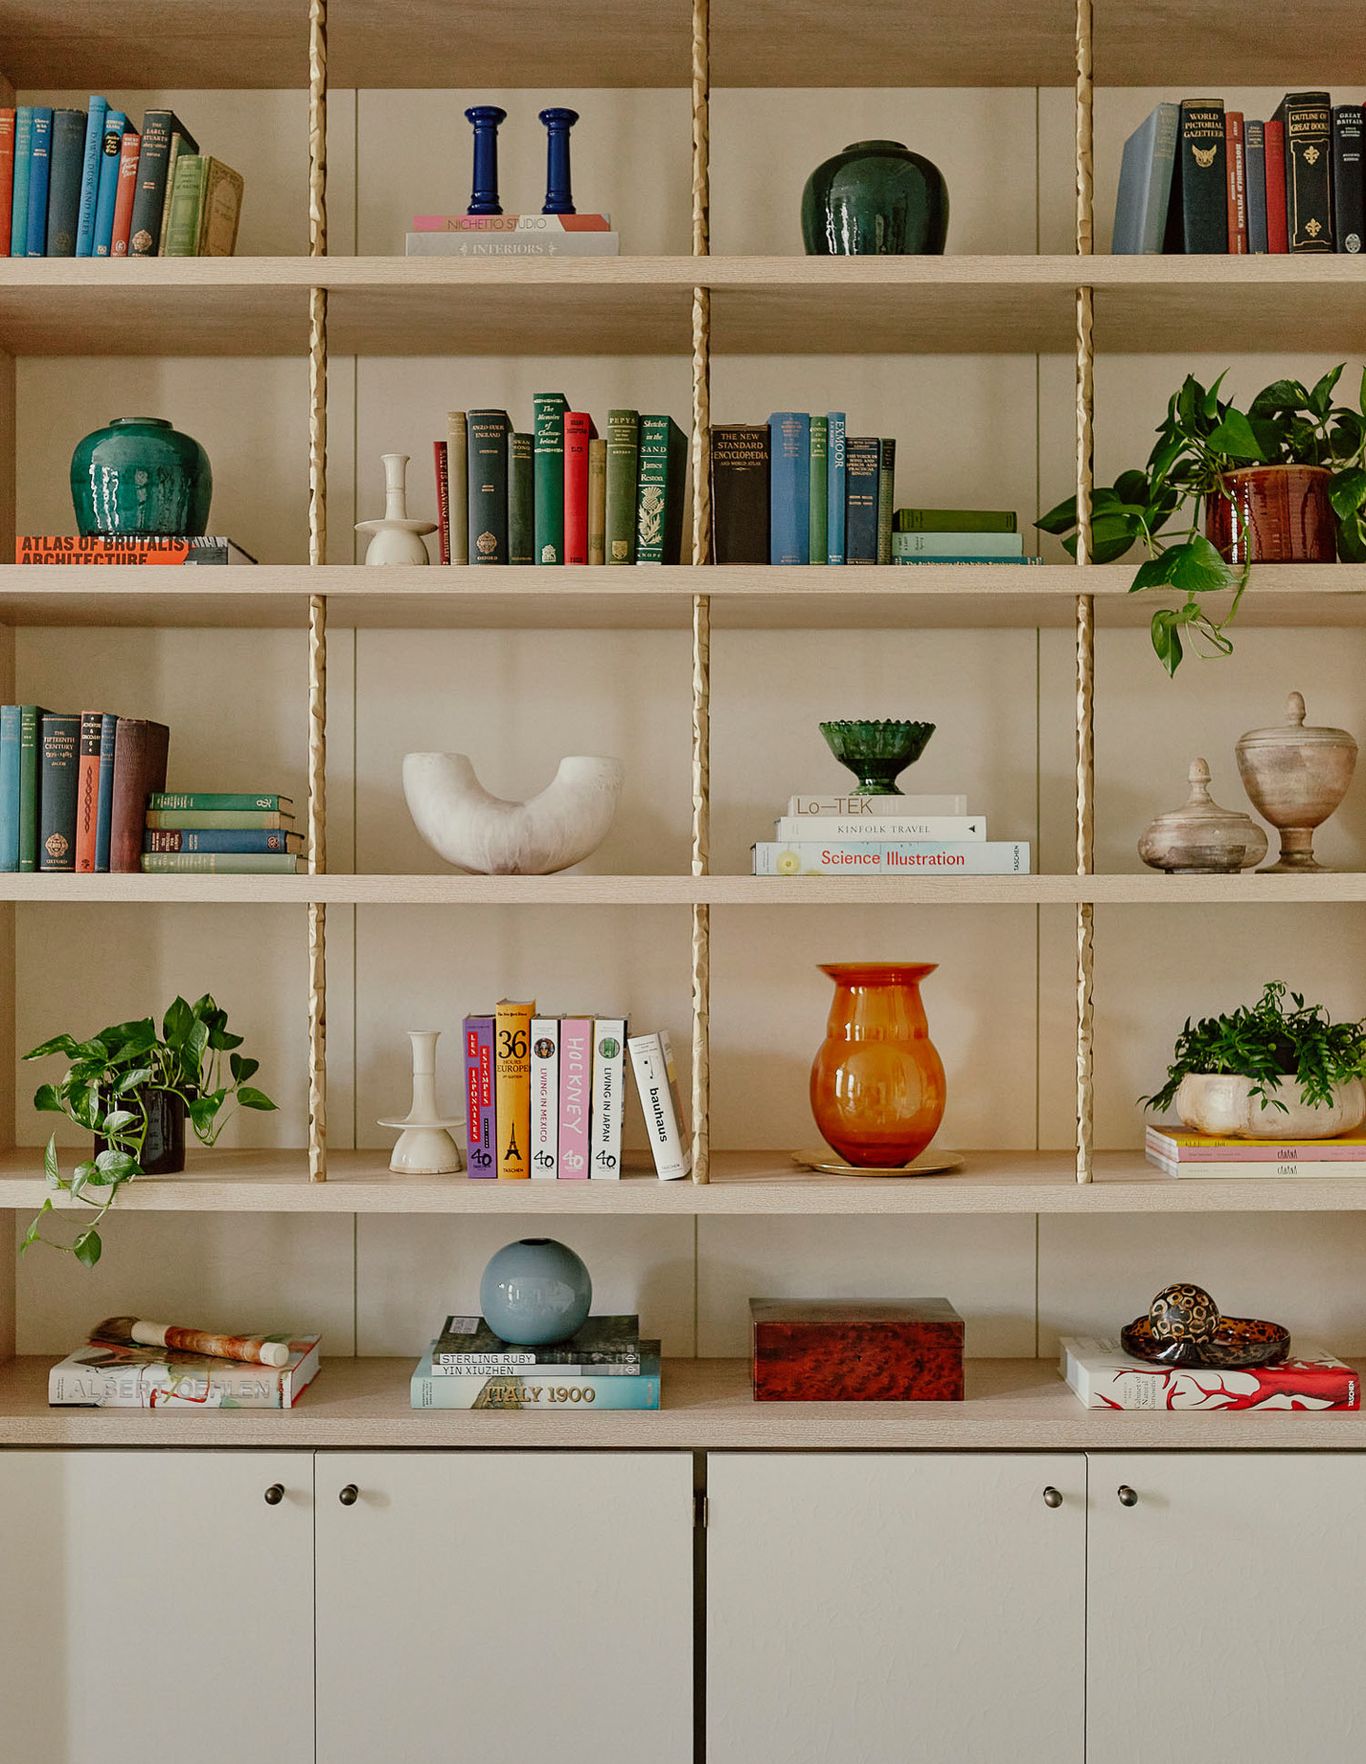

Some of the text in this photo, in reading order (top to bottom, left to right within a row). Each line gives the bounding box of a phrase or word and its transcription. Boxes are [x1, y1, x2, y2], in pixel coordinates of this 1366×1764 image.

[1184, 121, 1223, 129] PICTORIAL
[1291, 113, 1319, 121] OUTLINE
[1183, 130, 1224, 138] GAZETTEER
[1290, 122, 1310, 131] GREAT
[86, 163, 95, 188] DUSK
[1235, 143, 1243, 192] HOUSEHOLD
[84, 190, 92, 210] AND
[1236, 194, 1245, 228] PHYSICS
[81, 211, 90, 235] DEER
[447, 218, 547, 230] NICHETTO STUDIO
[473, 243, 544, 255] INTERIORS
[544, 421, 553, 430] of
[653, 432, 663, 440] the
[717, 441, 764, 449] STANDARD
[834, 421, 845, 469] EXMOOR
[641, 461, 663, 471] James
[640, 473, 664, 482] Reston
[440, 481, 448, 518] LEAVING
[21, 536, 74, 551] ATLAS
[79, 536, 98, 551] OF
[21, 552, 147, 565] ARCHITECTURE
[837, 825, 930, 834] KINFOLK TRAVEL
[821, 850, 965, 866] Science Illustration
[498, 1029, 527, 1059] 36
[481, 1047, 489, 1105] ESTAMPES
[496, 1064, 529, 1073] EUROPE
[562, 1036, 586, 1135] HOCKNEY
[470, 1069, 479, 1141] JAPONAISES
[602, 1067, 611, 1143] LIVING IN JAPAN
[649, 1087, 668, 1143] bauhaus
[471, 1148, 493, 1167] 40
[533, 1149, 555, 1168] 40
[595, 1149, 617, 1168] 40
[442, 1354, 532, 1364] STERLING RUBY
[443, 1366, 514, 1375] YIN XIUZHEN
[69, 1378, 170, 1399] ALBERT
[176, 1378, 271, 1399] OEHLEN
[484, 1386, 596, 1403] ITALY 1900
